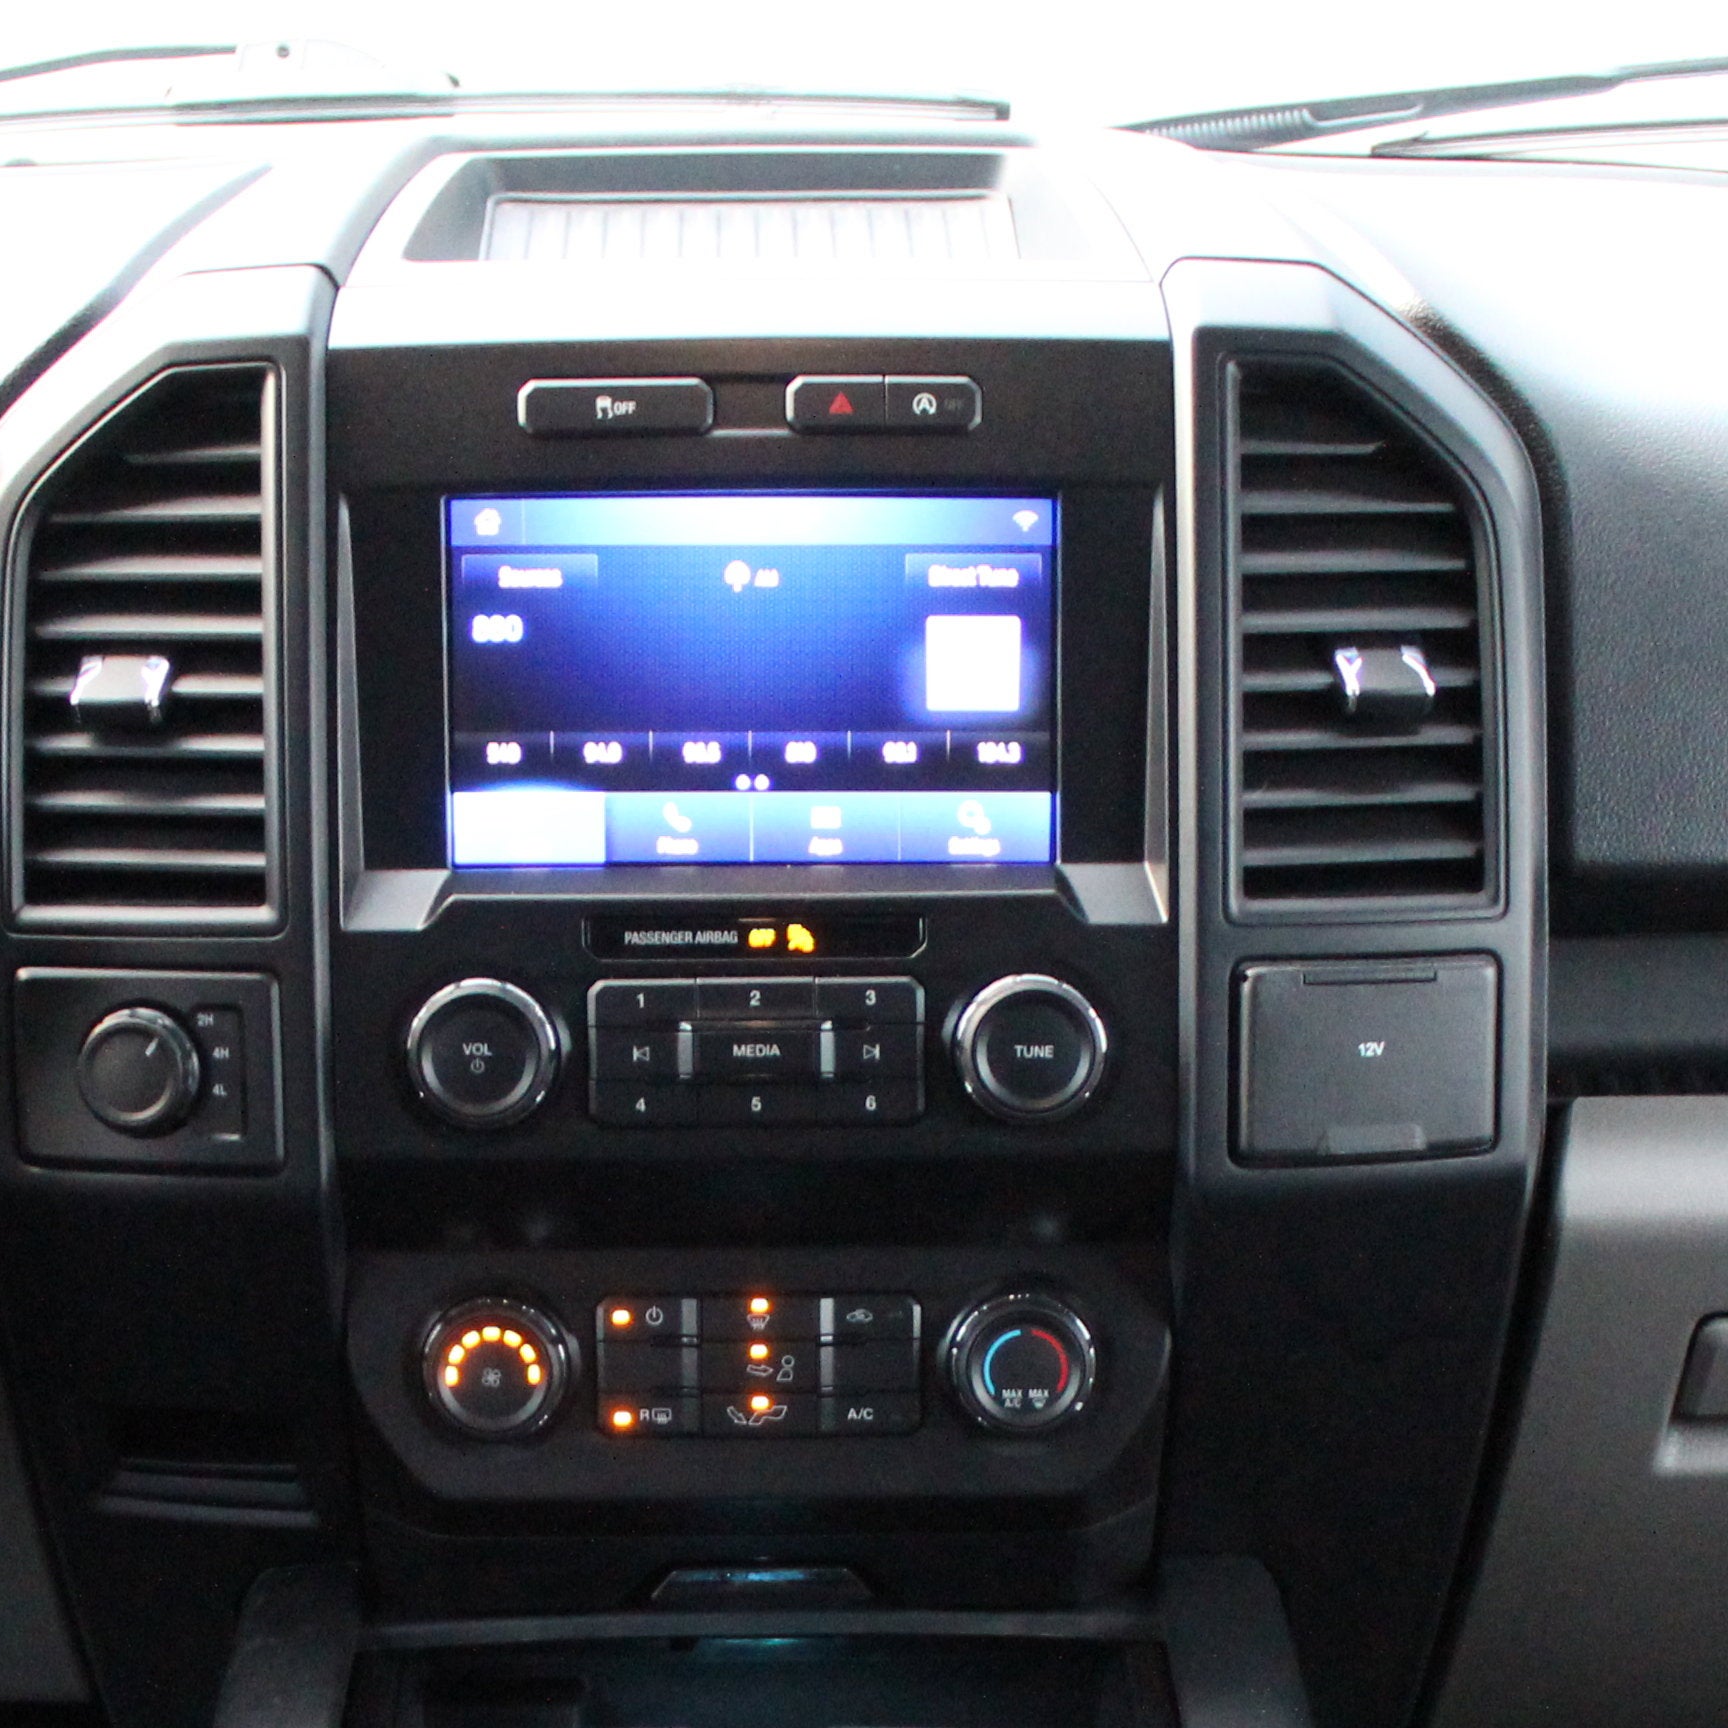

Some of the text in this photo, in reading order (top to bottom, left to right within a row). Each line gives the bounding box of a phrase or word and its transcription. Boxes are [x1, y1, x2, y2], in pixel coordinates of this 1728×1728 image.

[613, 400, 637, 416] OFF
[624, 931, 693, 945] PASSENGER
[695, 931, 739, 944] AIRBAG
[636, 992, 645, 1008] 1
[749, 990, 761, 1006] 2
[864, 990, 876, 1006] 3
[197, 1012, 214, 1027] 2H
[213, 1046, 229, 1059] 4H
[462, 1042, 492, 1056] VOL
[733, 1044, 781, 1057] MEDIA
[1014, 1045, 1054, 1058] TUNE
[1358, 1041, 1385, 1057] 12V
[212, 1083, 227, 1097] 4L
[635, 1097, 646, 1113] 4
[751, 1097, 762, 1112] 5
[865, 1095, 877, 1111] 6
[1002, 1388, 1023, 1399] MAX
[1028, 1388, 1049, 1399] MAX
[1004, 1399, 1022, 1409] A/C
[640, 1409, 650, 1421] R
[847, 1408, 873, 1420] A/C
